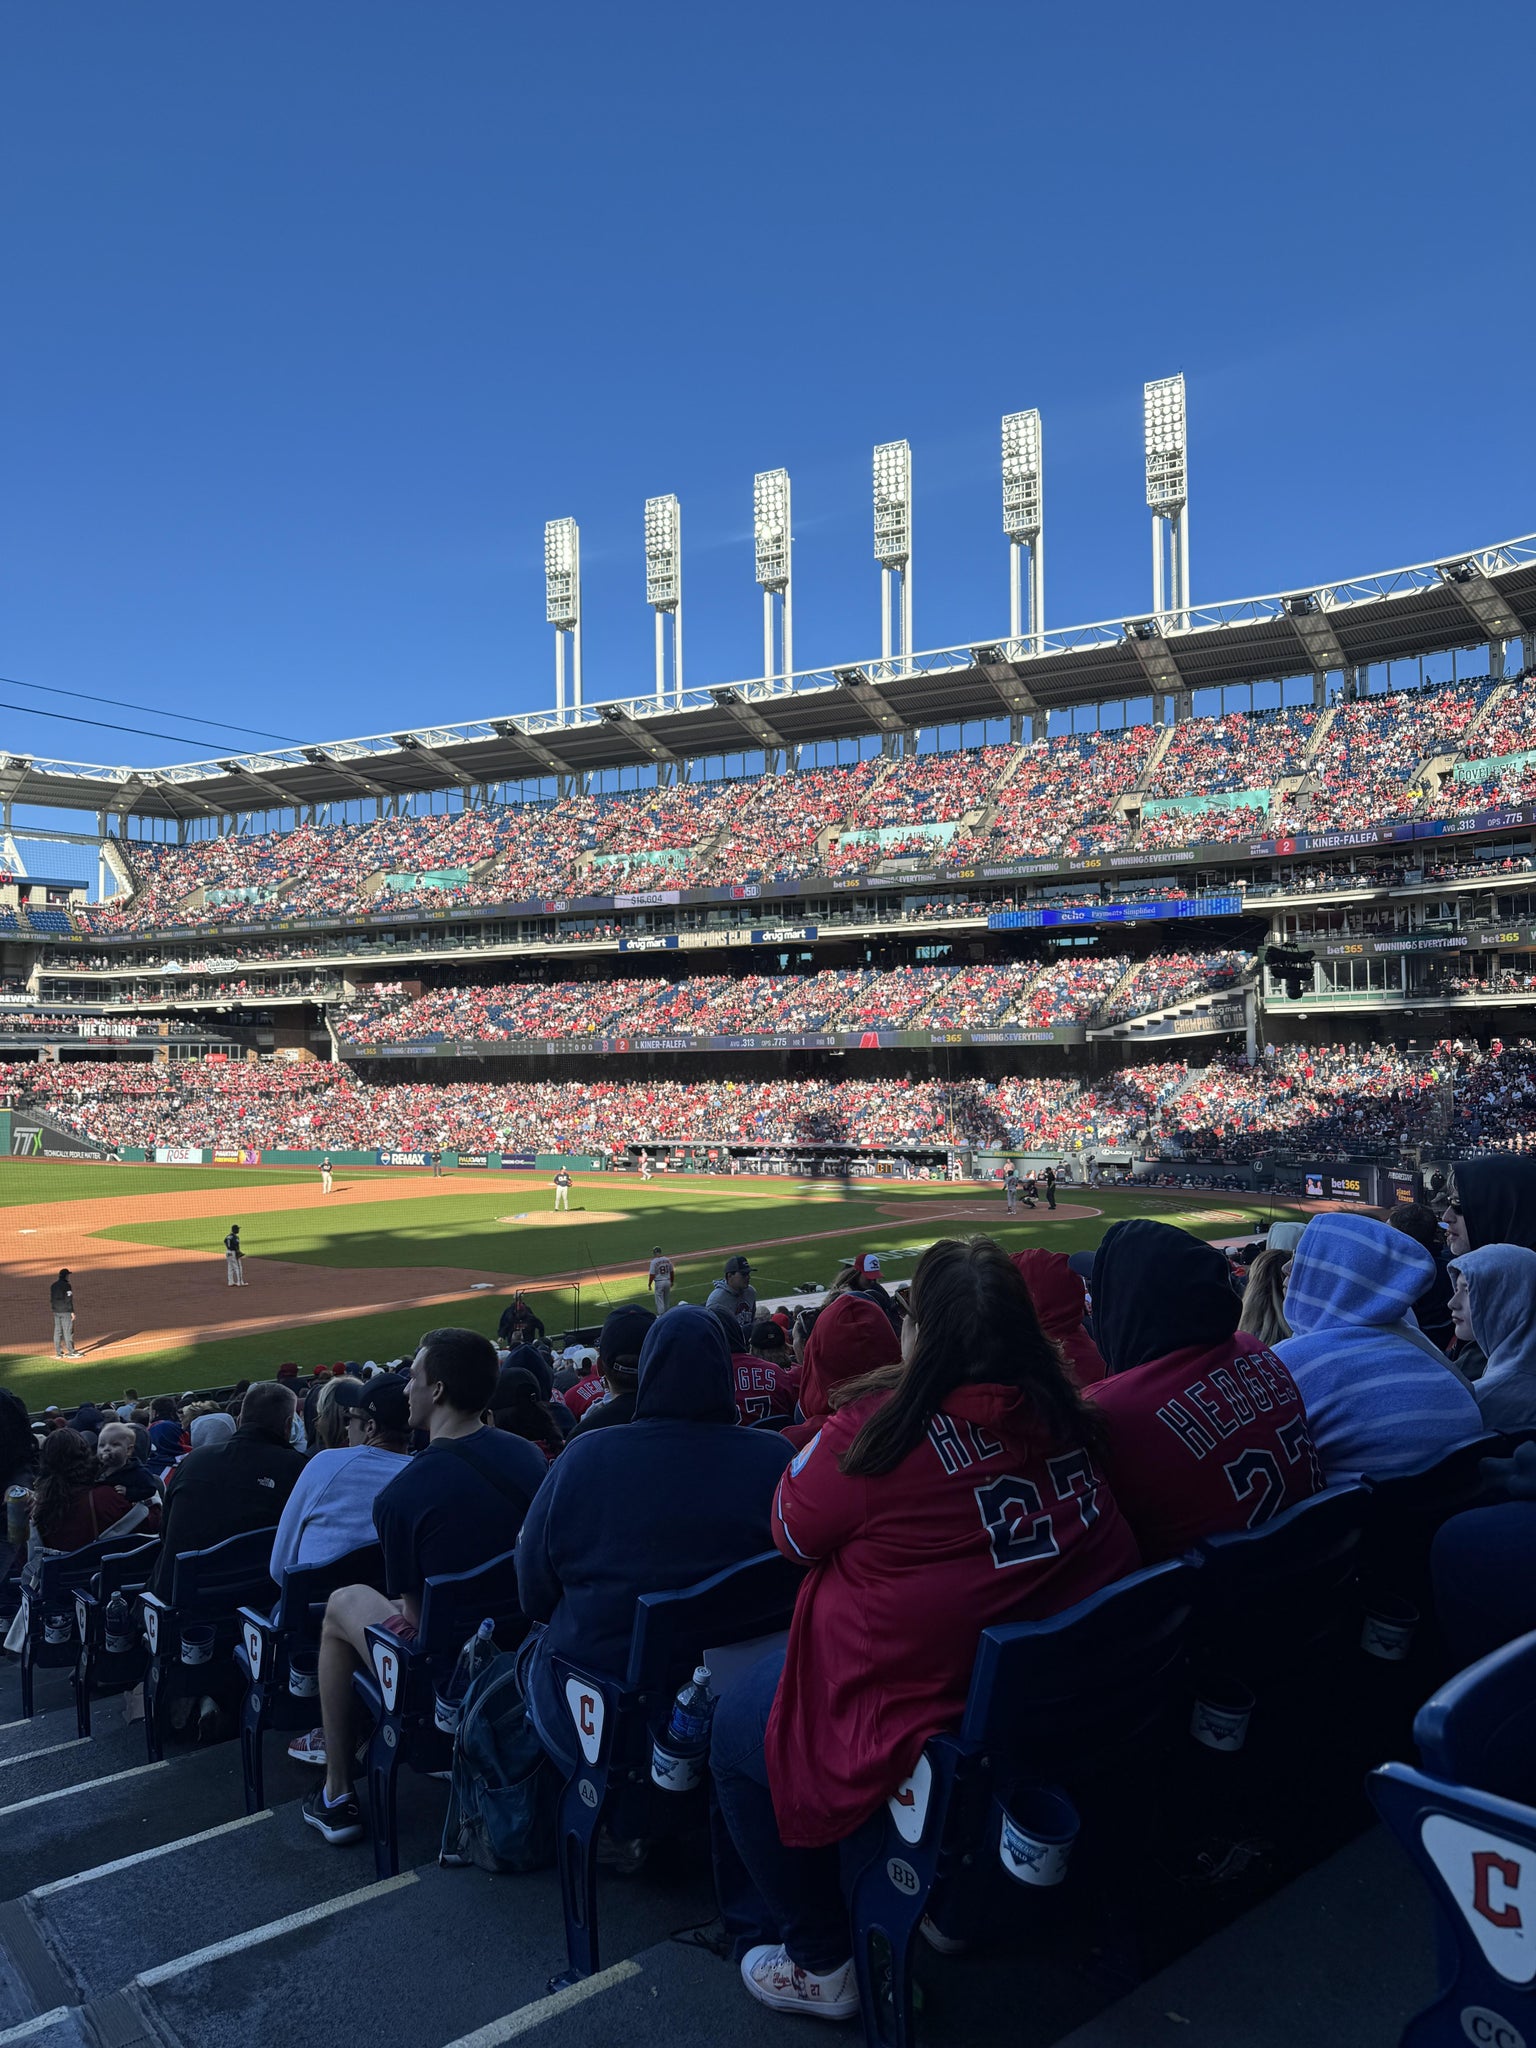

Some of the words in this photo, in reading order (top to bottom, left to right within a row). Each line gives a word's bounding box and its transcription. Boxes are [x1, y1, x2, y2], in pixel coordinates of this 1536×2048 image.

[1488, 818, 1501, 826] OPS
[1502, 812, 1522, 824] .775
[1442, 825, 1456, 833] AVG
[1457, 819, 1476, 831] .313
[1283, 842, 1290, 852] 2
[1312, 832, 1378, 848] KINER-FALEFA
[1070, 859, 1102, 870] bet365
[1110, 856, 1144, 866] WINNING
[1150, 852, 1195, 863] EVERYTHING
[946, 870, 976, 880] bet365
[1018, 863, 1059, 874] EVERYTHING
[833, 880, 860, 888] bet365
[1061, 910, 1085, 920] echo
[762, 932, 784, 942] drug
[784, 930, 806, 940] mart
[1481, 932, 1520, 944] bet365
[626, 940, 646, 950] drug
[646, 938, 666, 948] mart
[1327, 944, 1363, 955] bet365
[1374, 942, 1412, 952] WINNING
[1418, 937, 1468, 949] EVERYTHING
[1225, 1004, 1242, 1012] mart
[1174, 1016, 1222, 1033] CHAMPIONS
[1223, 1014, 1245, 1028] CLUB
[79, 1024, 98, 1037] THE
[98, 1024, 138, 1037] CORNER
[741, 1038, 755, 1046] .313
[772, 1038, 786, 1046] .775
[827, 1037, 835, 1045] 10
[931, 1034, 962, 1042] bet365
[620, 1041, 625, 1050] 2
[640, 1040, 687, 1049] KINER-FALEFA
[166, 1149, 190, 1162] ROSE
[1332, 1178, 1360, 1190] bet365
[1156, 1351, 1298, 1460] HEDGES
[1222, 1414, 1328, 1530] 27
[974, 1447, 1102, 1569] 27
[382, 1656, 392, 1689] C
[580, 1694, 594, 1735] C
[581, 1785, 596, 1804] AA
[892, 1863, 916, 1890] BB
[1472, 1852, 1522, 1928] C
[1472, 2016, 1516, 2048] CC
